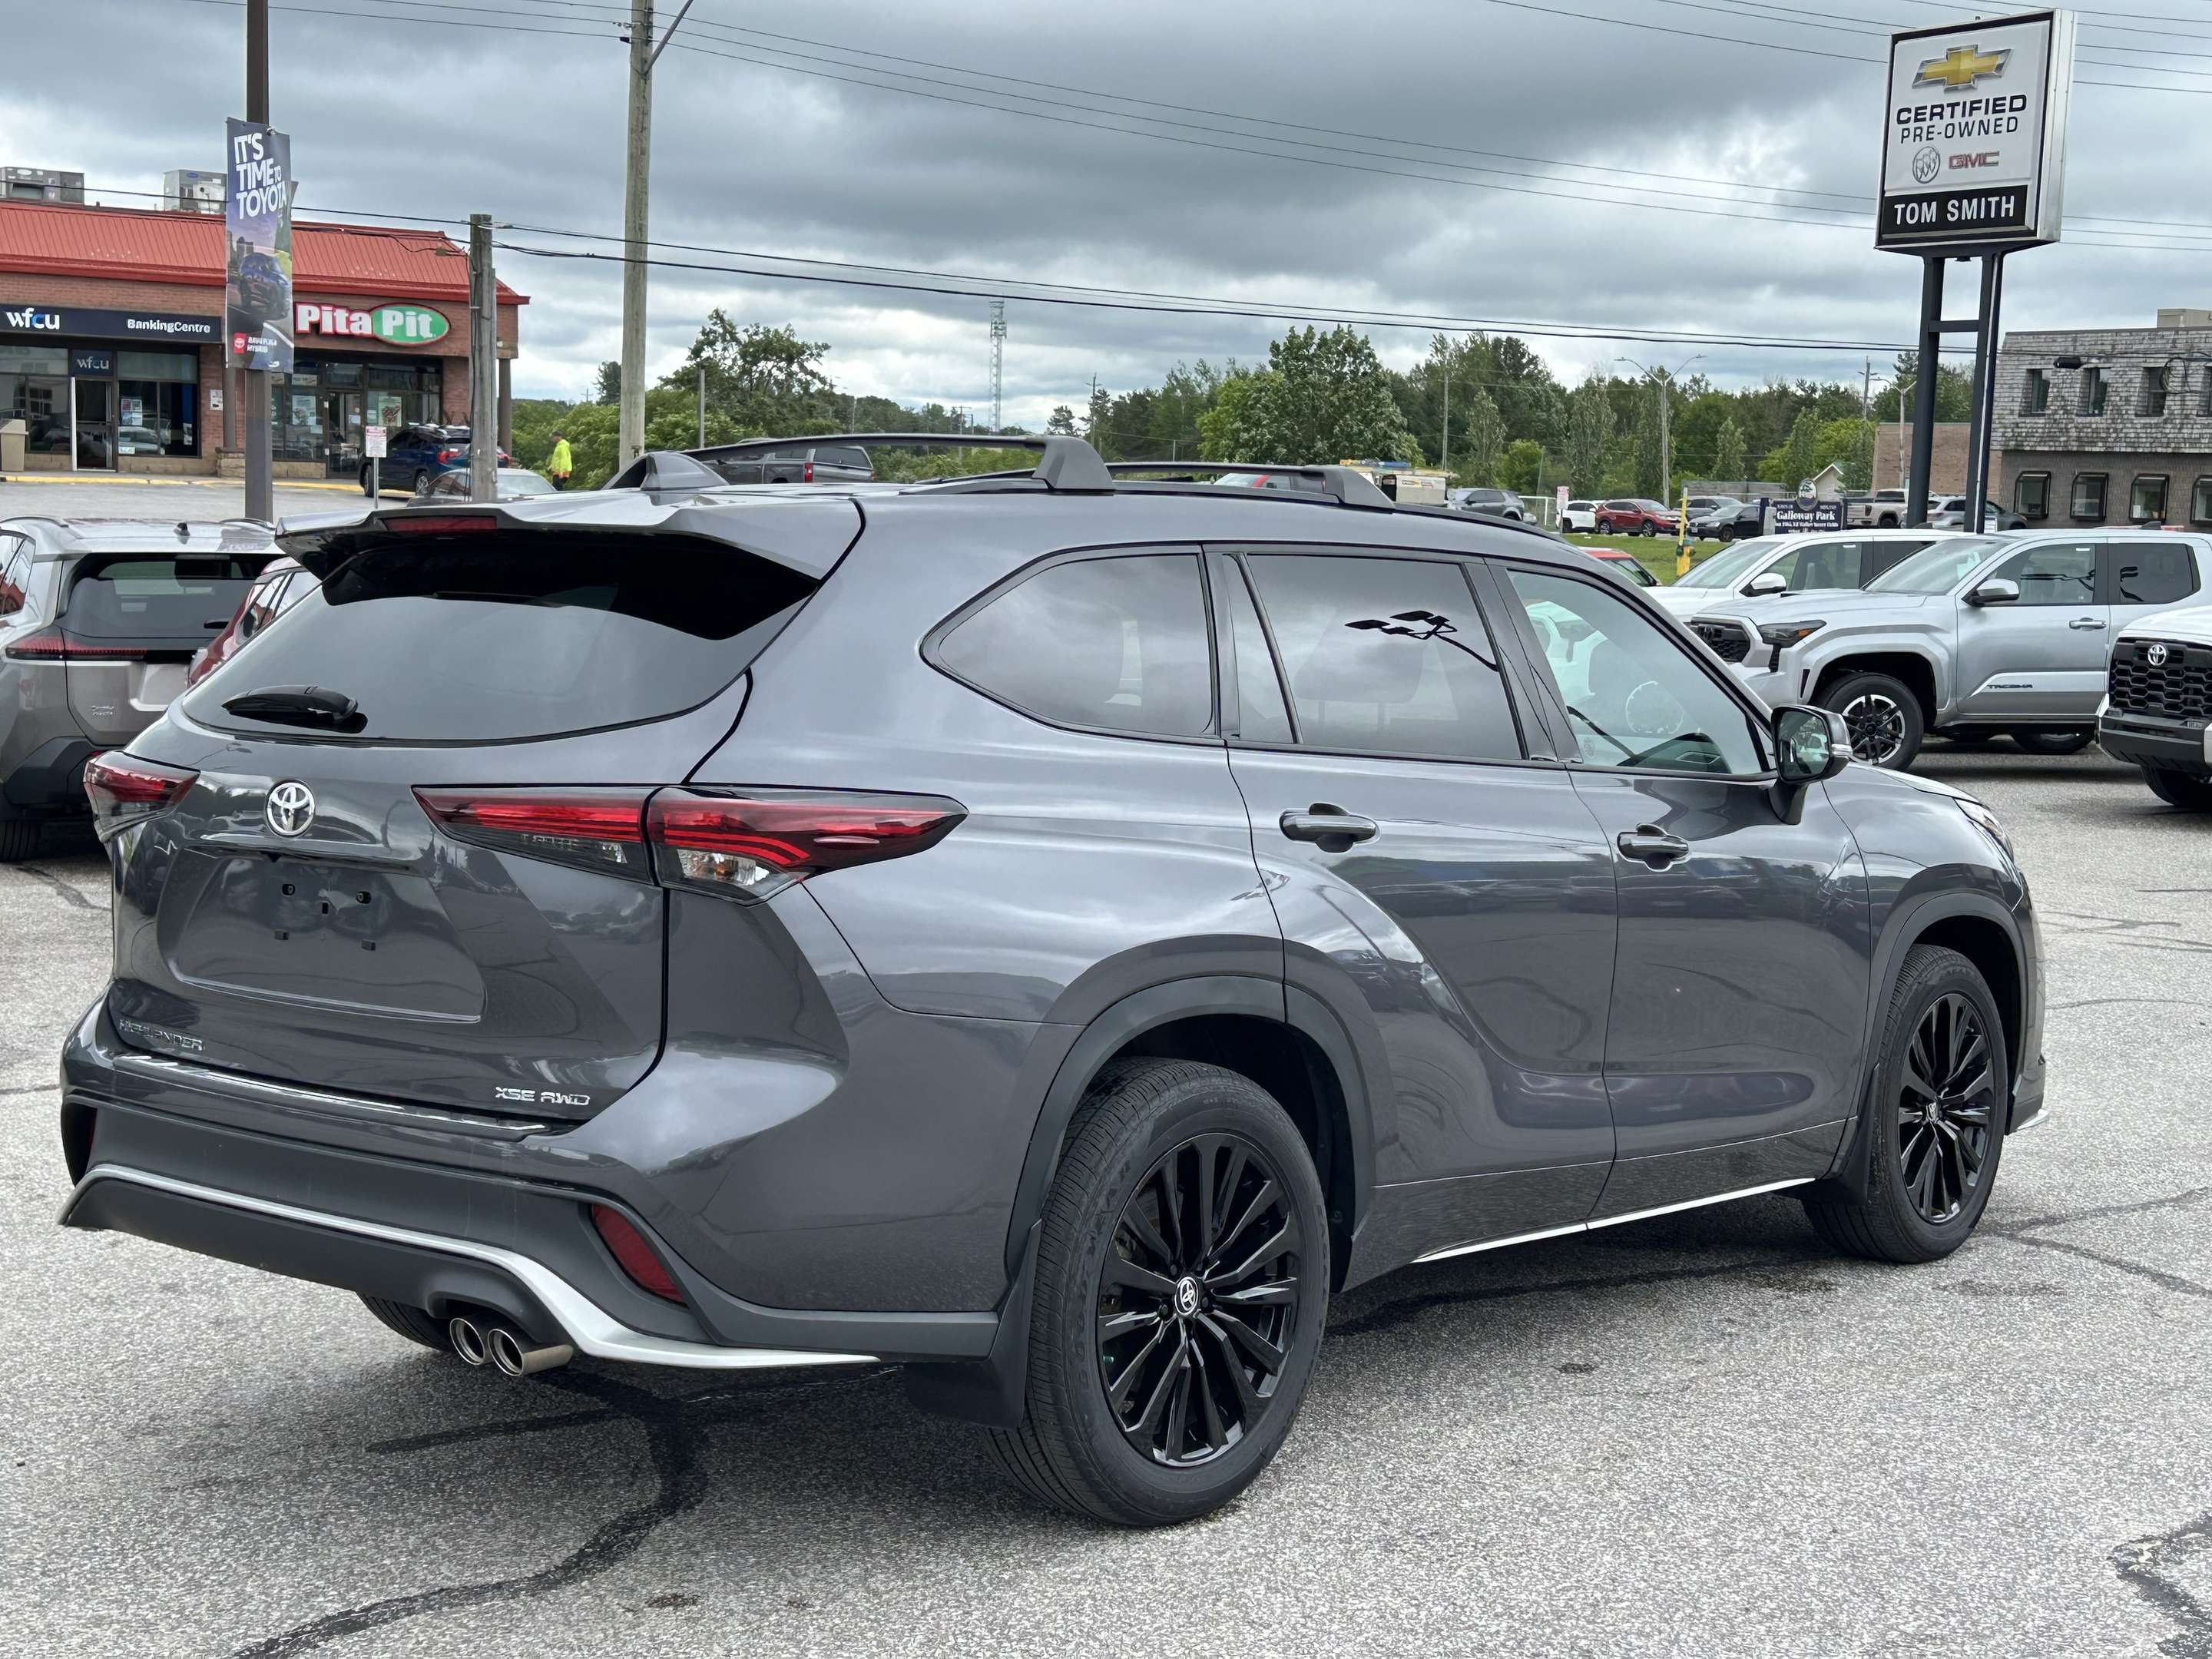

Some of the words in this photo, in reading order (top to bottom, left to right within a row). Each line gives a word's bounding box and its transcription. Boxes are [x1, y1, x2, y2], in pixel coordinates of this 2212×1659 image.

[1896, 94, 2027, 125] CERTIFIED
[1901, 116, 2018, 144] PRE-OWNED
[234, 132, 264, 164] IT'S
[1949, 151, 2000, 170] GMC
[236, 157, 274, 191] TIME
[274, 165, 282, 183] TO
[236, 180, 287, 220] TOYOTA
[1894, 201, 1938, 225] TOM
[1946, 195, 2015, 224] SMITH
[6, 307, 60, 330] wfcu
[127, 319, 211, 333] BankingCentre
[296, 304, 373, 335] Pita
[382, 310, 433, 339] Pit
[77, 356, 110, 370] wfcu
[1816, 511, 1836, 521] Park
[495, 1087, 536, 1101] XSE
[540, 1091, 591, 1106] AWD
